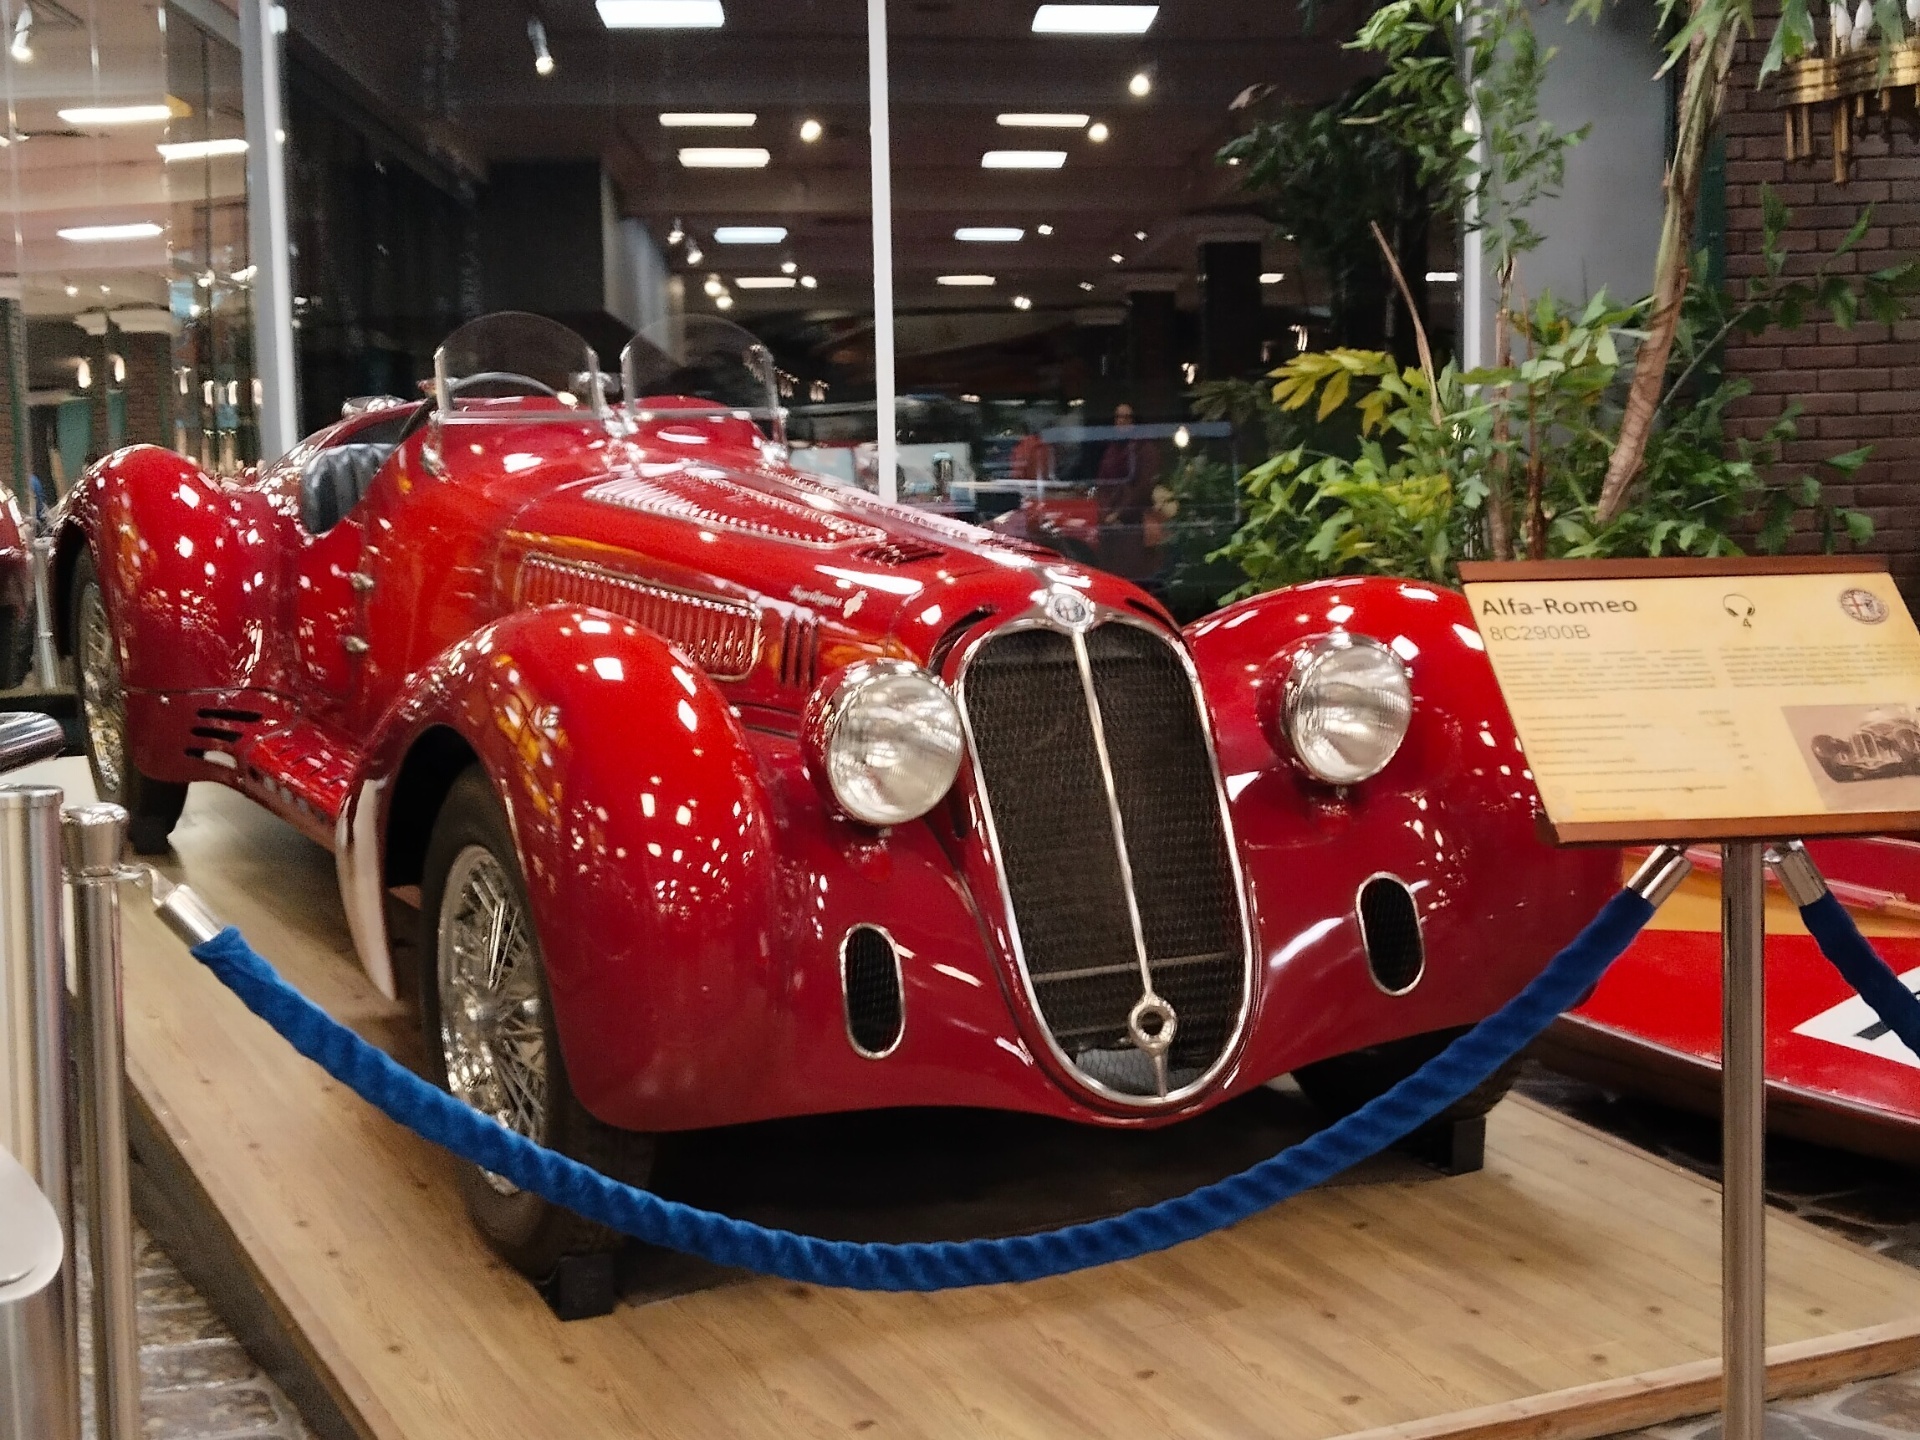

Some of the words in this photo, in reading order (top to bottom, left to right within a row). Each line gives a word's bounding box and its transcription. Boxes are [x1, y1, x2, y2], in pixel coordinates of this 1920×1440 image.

[1483, 597, 1637, 616] Alfa-Romeo
[1743, 617, 1752, 629] 4
[1490, 625, 1591, 642] 8C2900B
